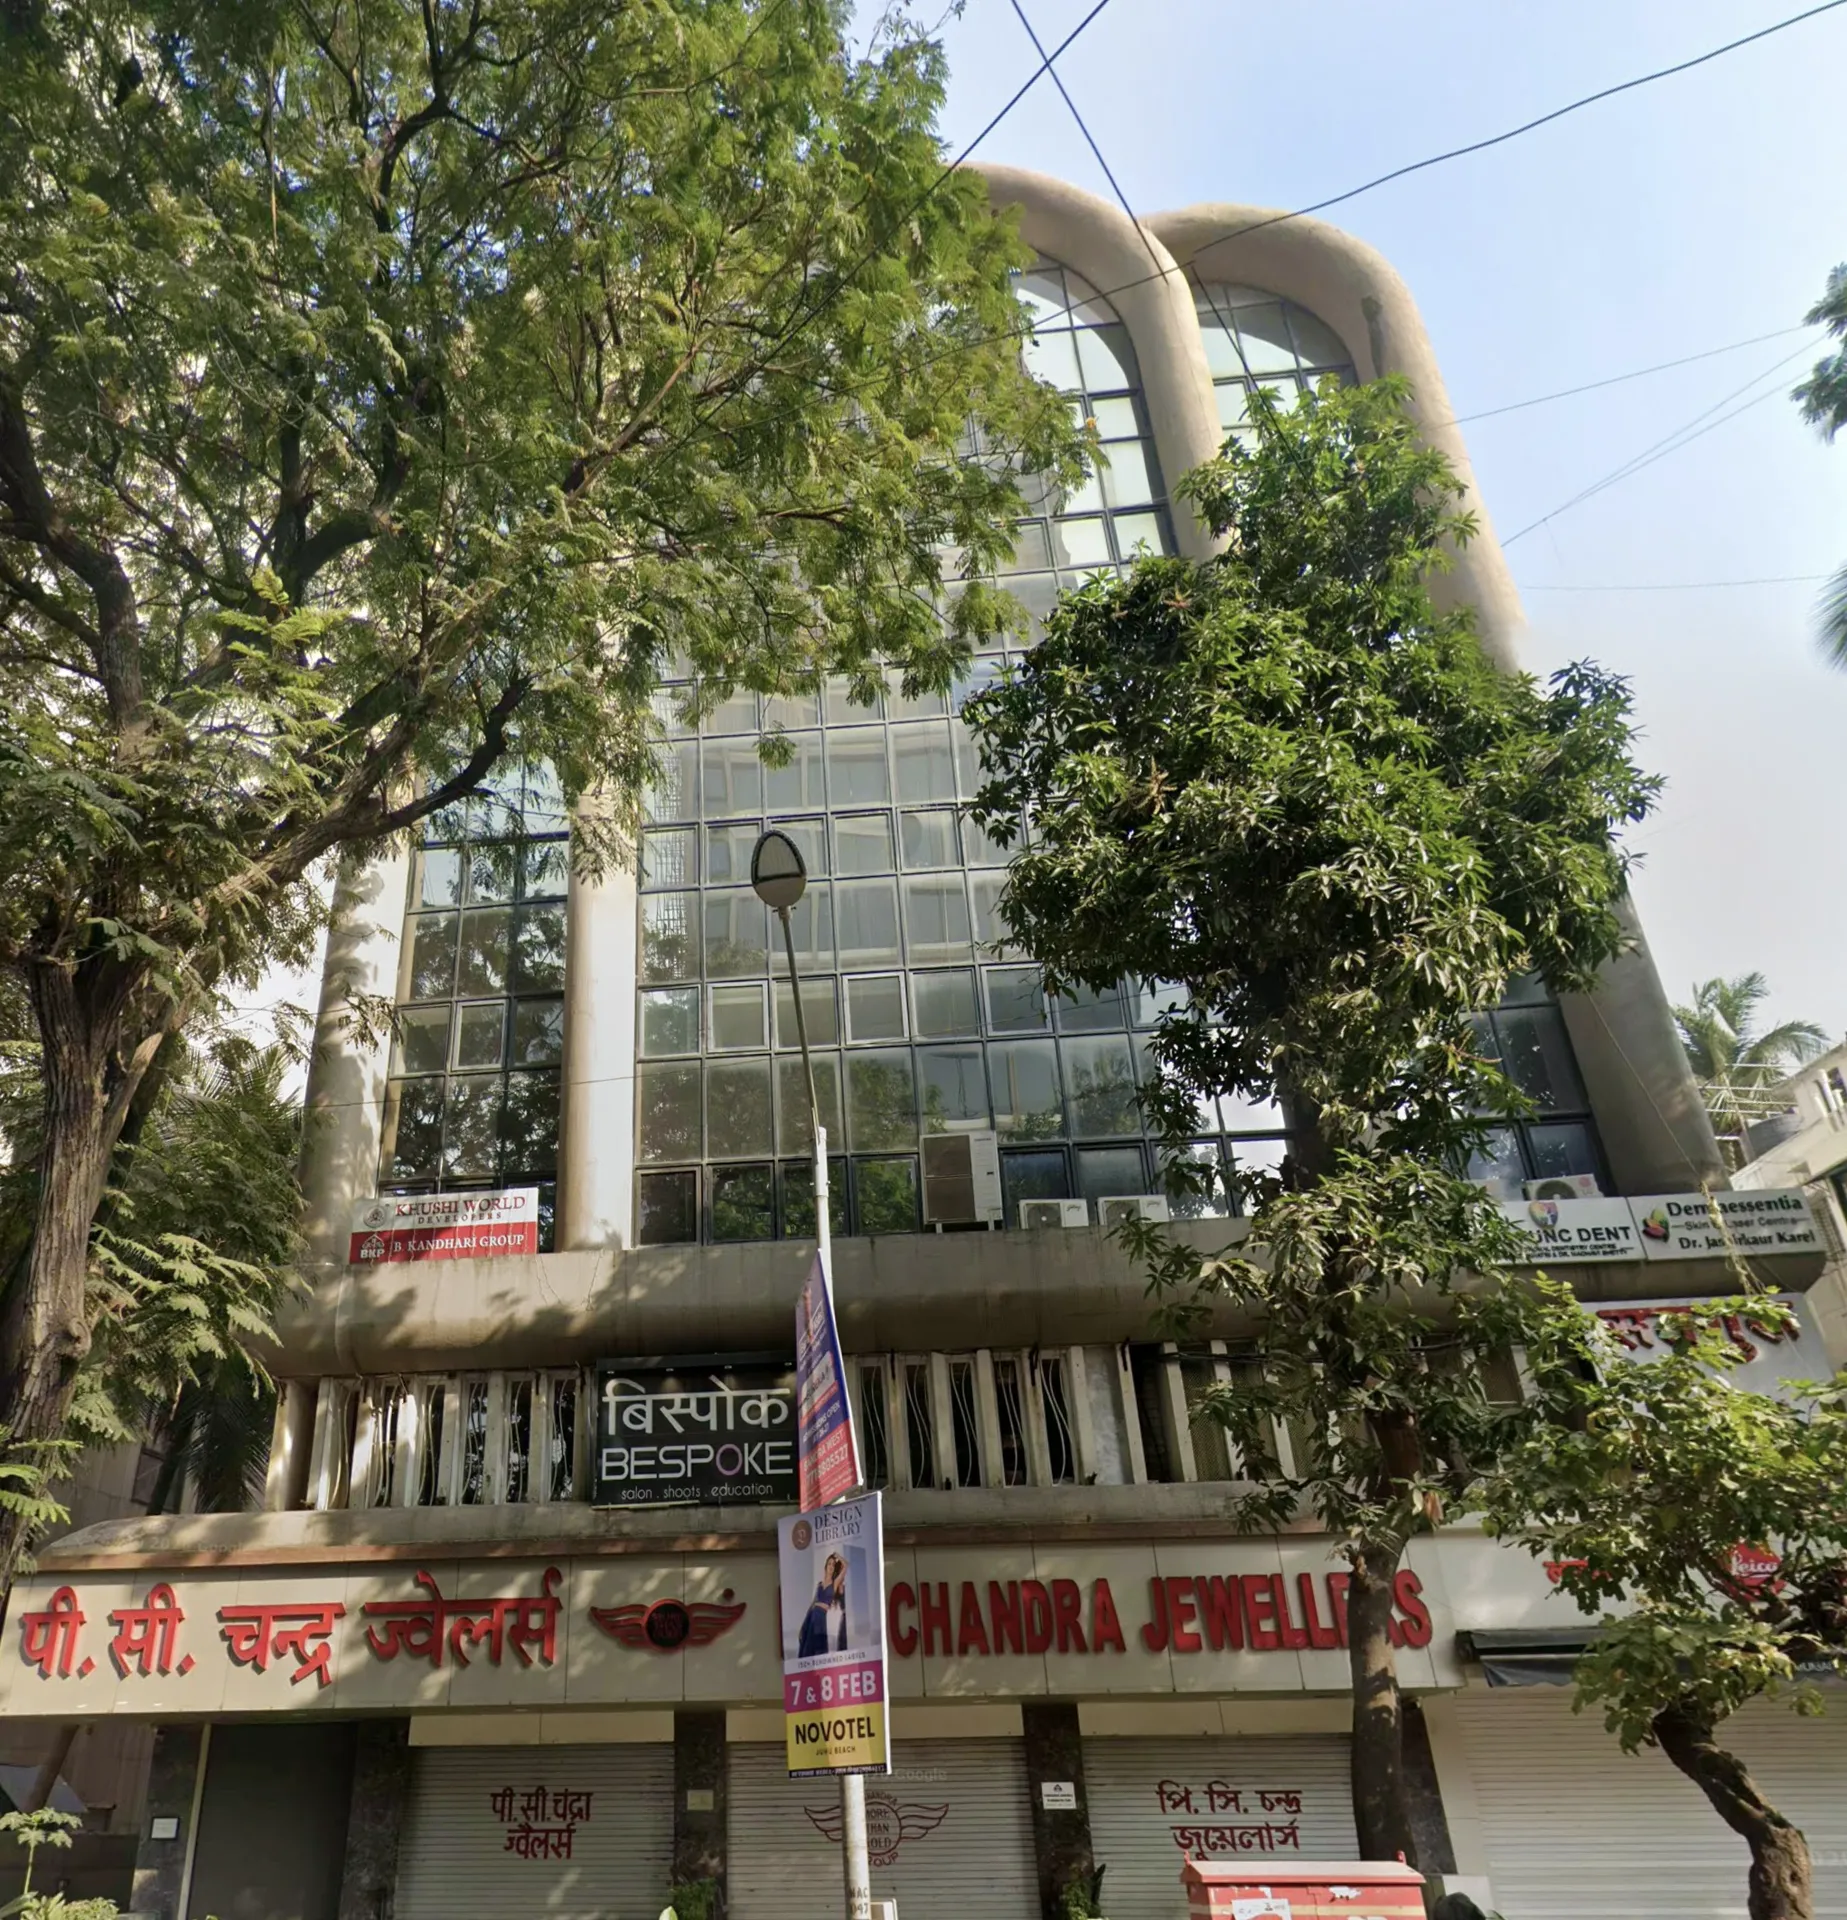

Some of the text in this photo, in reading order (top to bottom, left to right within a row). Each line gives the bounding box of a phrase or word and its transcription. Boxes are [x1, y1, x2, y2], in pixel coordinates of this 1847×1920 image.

[395, 1196, 526, 1217] KHUSHI WORLD
[418, 1211, 502, 1225] DEVELOPERS
[407, 1237, 476, 1252] KANDHARI
[479, 1234, 524, 1248] GROUP
[1576, 1226, 1631, 1241] DENT
[1678, 1236, 1702, 1249] Dr.
[359, 1249, 386, 1259] BKP
[602, 1375, 790, 1436] बिस्पोक
[602, 1440, 794, 1481] BESPOKE
[621, 1482, 773, 1500] salon shoots education
[814, 1504, 863, 1530] DESIGN
[814, 1519, 863, 1544] LIBRARY
[21, 1567, 563, 1688] पी. सी. चन्द्र ज्वेलर्स
[889, 1577, 1127, 1657] CHANDRA
[790, 1670, 877, 1706] 7 & 8 FEB
[795, 1716, 875, 1745] NOVOTEL
[834, 1745, 856, 1755] BEACH
[867, 1837, 892, 1849] OLD
